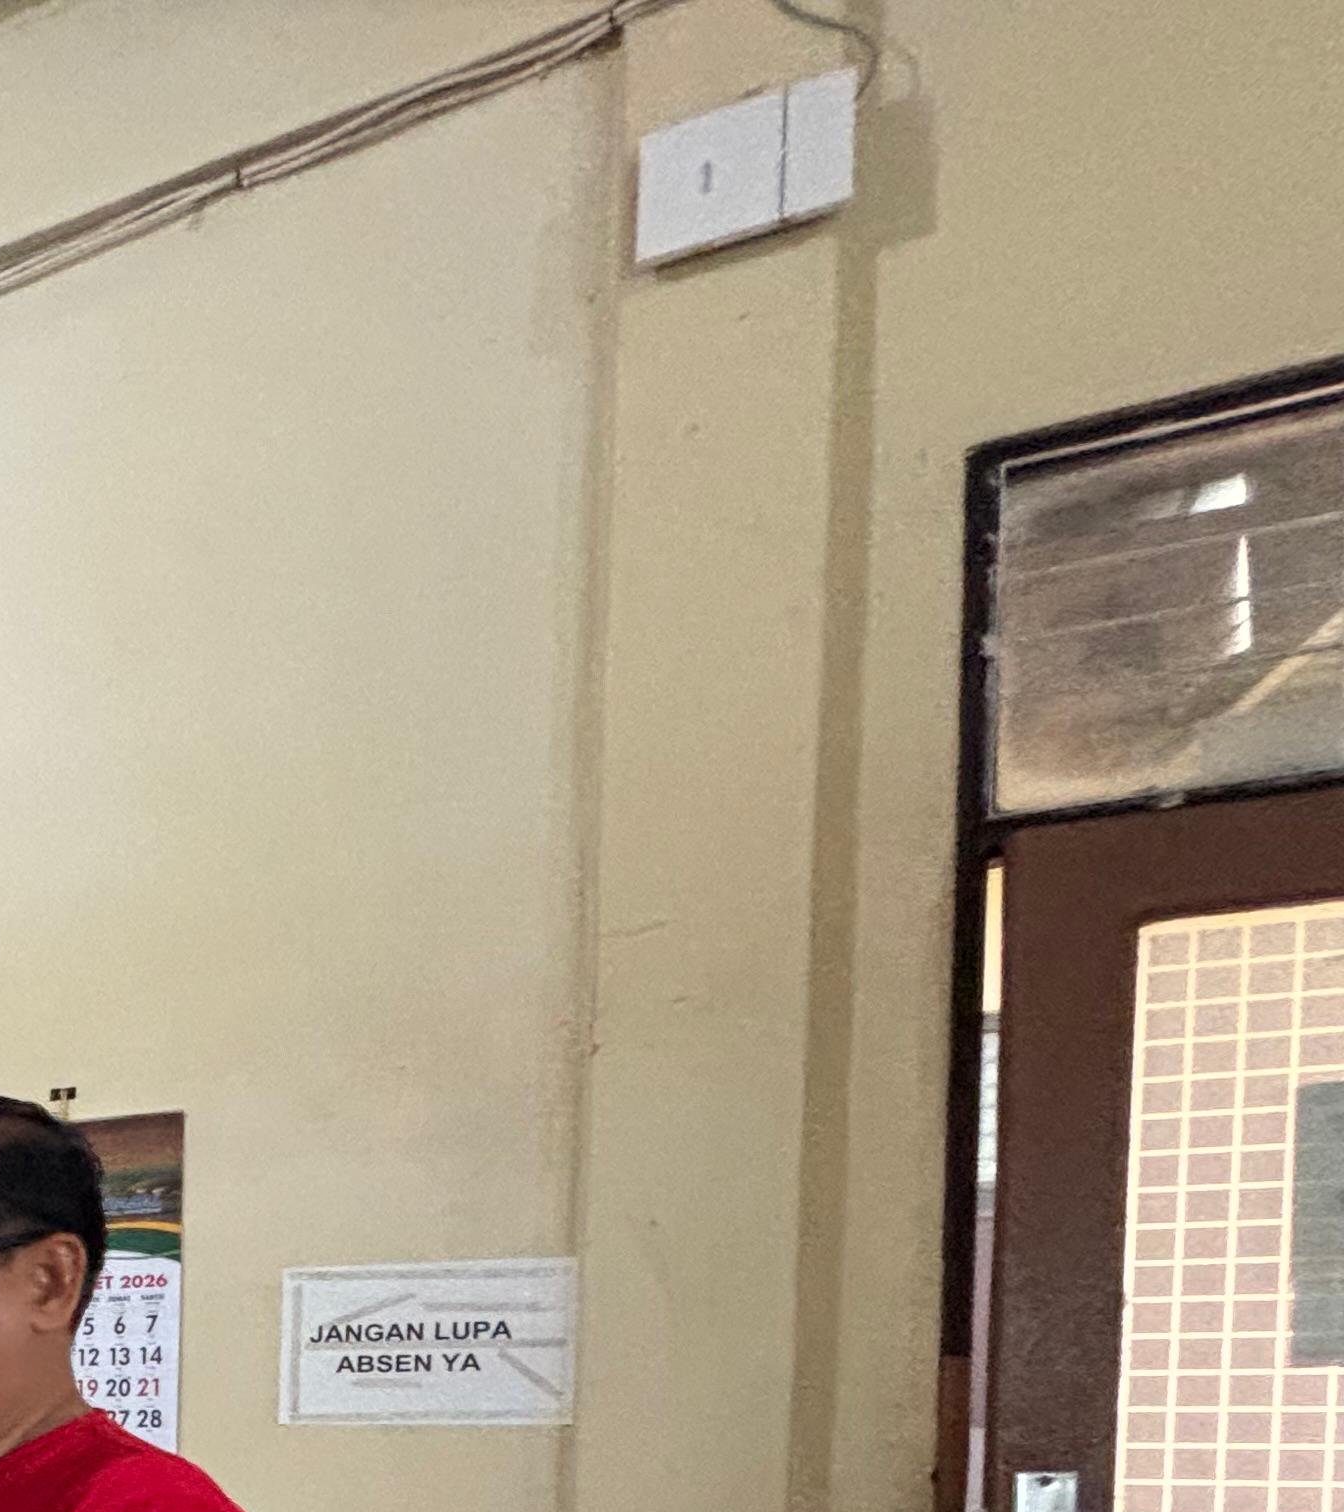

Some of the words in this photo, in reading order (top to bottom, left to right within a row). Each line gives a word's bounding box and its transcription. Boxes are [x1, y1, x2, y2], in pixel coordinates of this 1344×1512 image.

[120, 1274, 168, 1289] 2026
[82, 1317, 95, 1335] 5
[114, 1316, 126, 1334] 6
[145, 1314, 158, 1333] 7
[310, 1322, 425, 1344] JANGAN
[434, 1320, 512, 1341] LUPA
[78, 1348, 100, 1366] 12
[110, 1347, 131, 1366] 13
[141, 1346, 162, 1365] 14
[336, 1354, 432, 1374] ABSEN
[442, 1353, 481, 1373] YA
[77, 1379, 98, 1397] 19
[106, 1378, 131, 1397] 20
[137, 1377, 160, 1397] 21
[137, 1409, 162, 1428] 28
